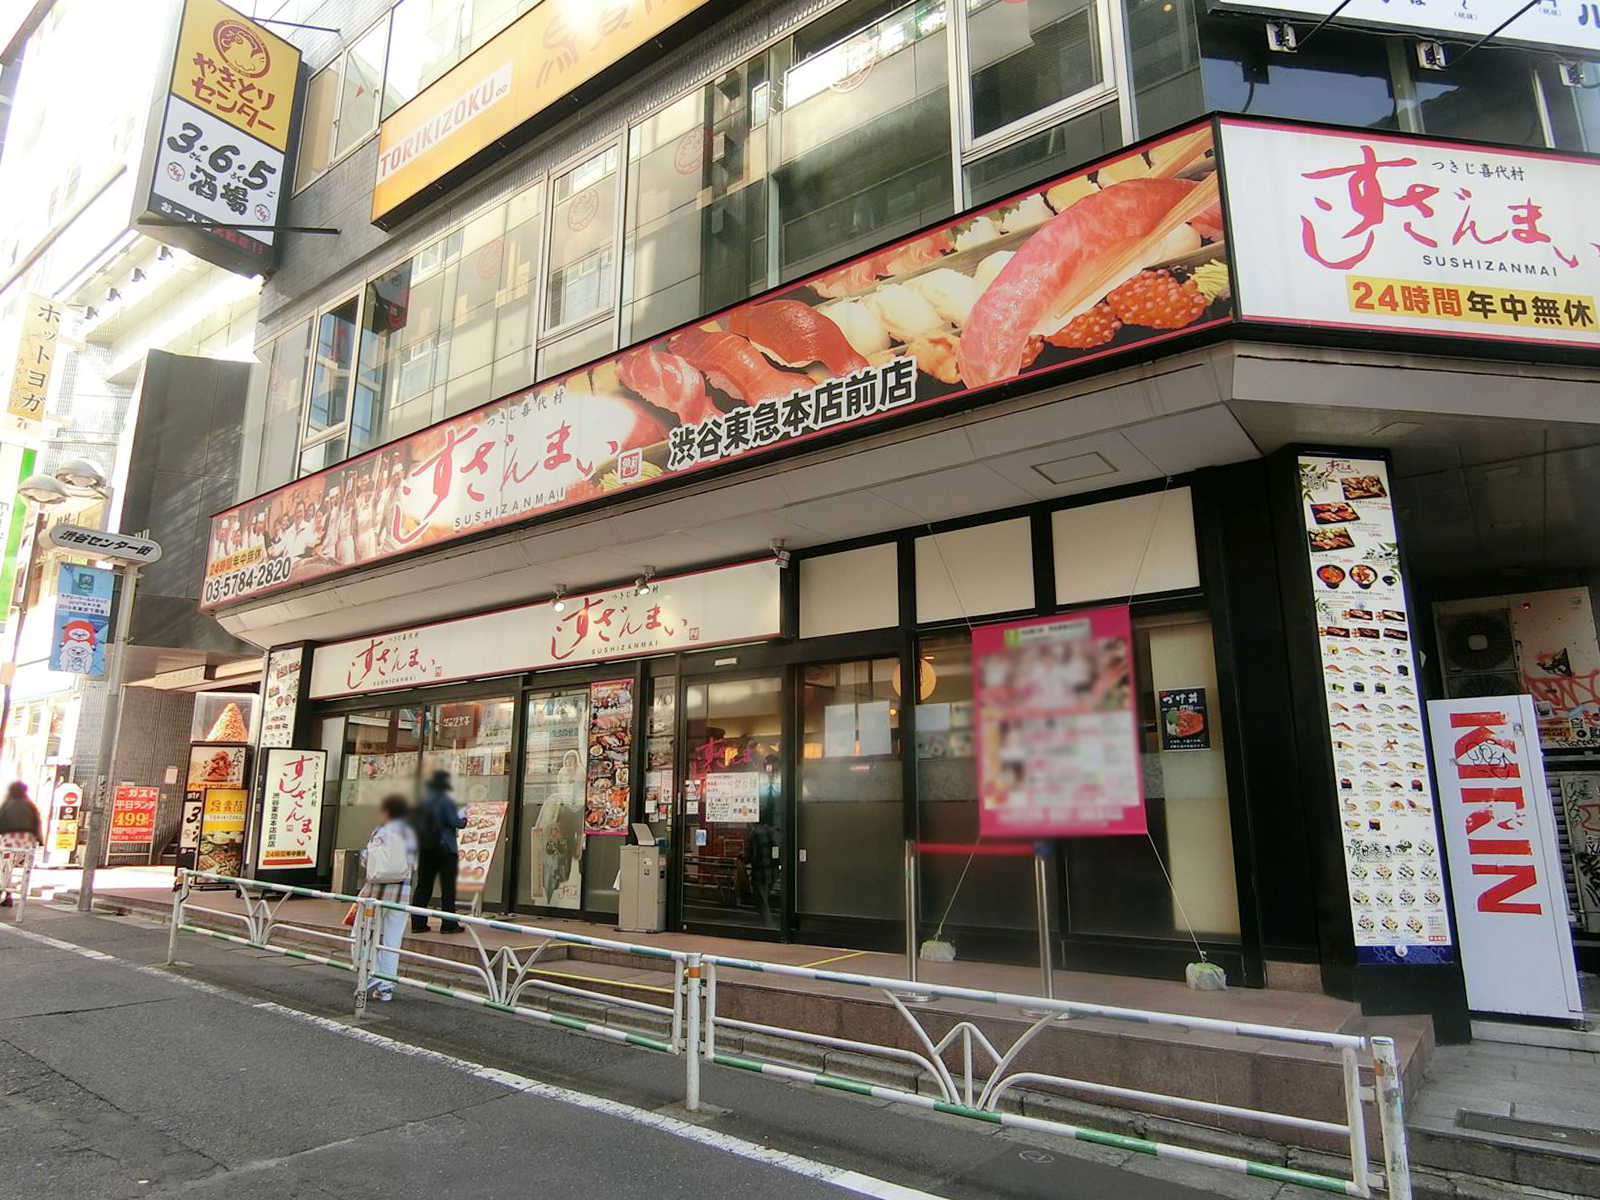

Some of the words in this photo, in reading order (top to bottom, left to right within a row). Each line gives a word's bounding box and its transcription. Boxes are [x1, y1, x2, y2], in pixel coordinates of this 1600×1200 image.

[191, 77, 276, 133] センター
[192, 52, 276, 112] やきとり
[380, 78, 496, 177] TORIKIZOKU
[188, 165, 249, 216] 酒場
[1431, 159, 1526, 182] つきじ喜代村
[1422, 253, 1558, 278] SUSHIZANMAI
[22, 304, 61, 412] ホットヨガ
[669, 358, 915, 467] 渋谷東急本店前店
[392, 419, 620, 544] すしざんまい
[455, 486, 566, 528] SUSHIZANMAI
[59, 530, 154, 557] 渋谷センター街
[205, 556, 292, 602] 03-5784-2820
[551, 597, 688, 660] すしざんまい
[591, 640, 659, 656] SUSHIZANMAI
[347, 639, 435, 690] すしざんまい
[1162, 692, 1197, 704] づけ丼
[128, 789, 157, 798] ガスト
[279, 755, 313, 846] すしざんまい
[1449, 710, 1542, 916] KIRIN
